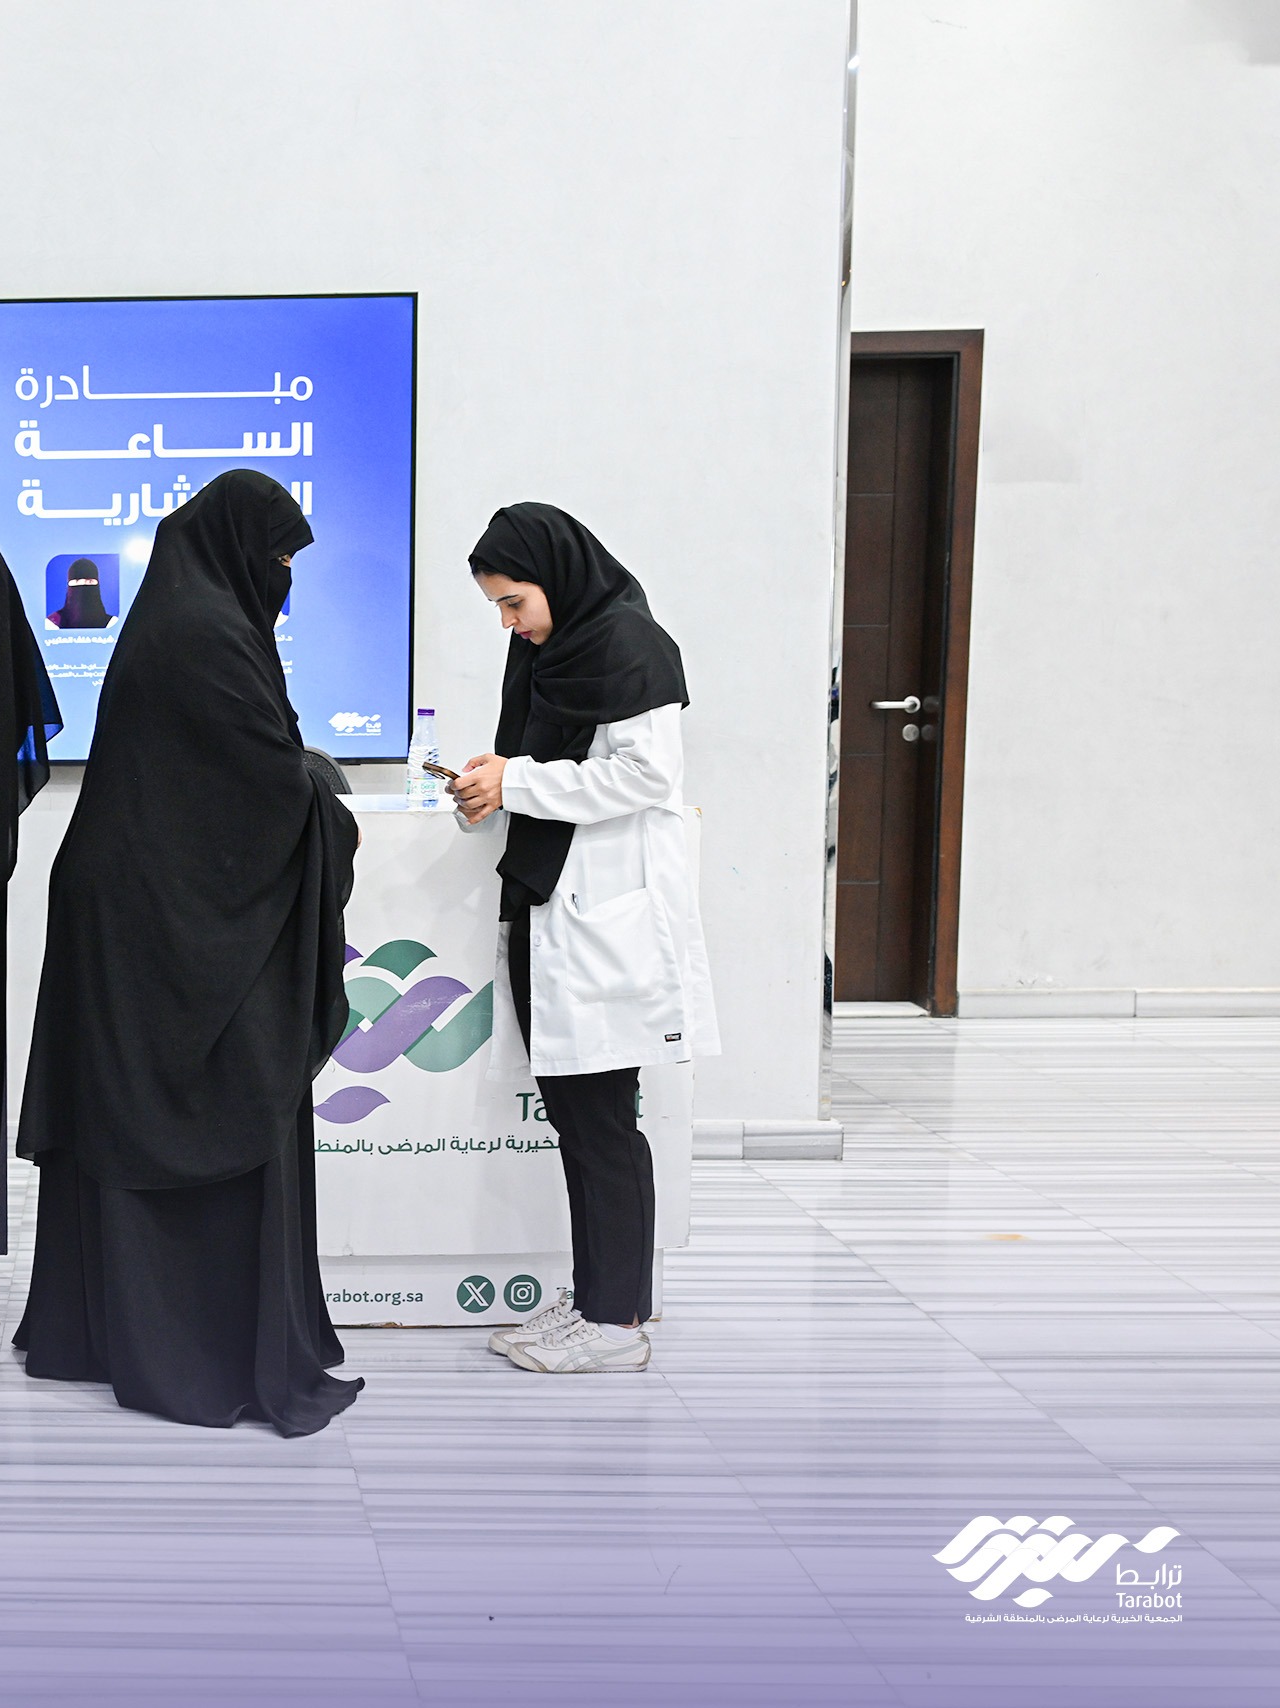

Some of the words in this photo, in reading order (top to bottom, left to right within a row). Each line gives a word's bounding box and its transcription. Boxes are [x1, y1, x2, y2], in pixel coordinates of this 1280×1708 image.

[15, 365, 314, 408] مبادرة
[14, 419, 313, 460] الساعة
[17, 474, 312, 526] الشارية
[315, 1139, 373, 1155] بالمنط
[377, 1138, 446, 1156] المرضى
[450, 1136, 501, 1154] لرعاية
[505, 1134, 560, 1153] لخيرية
[326, 1288, 424, 1306] rabot.org.sa
